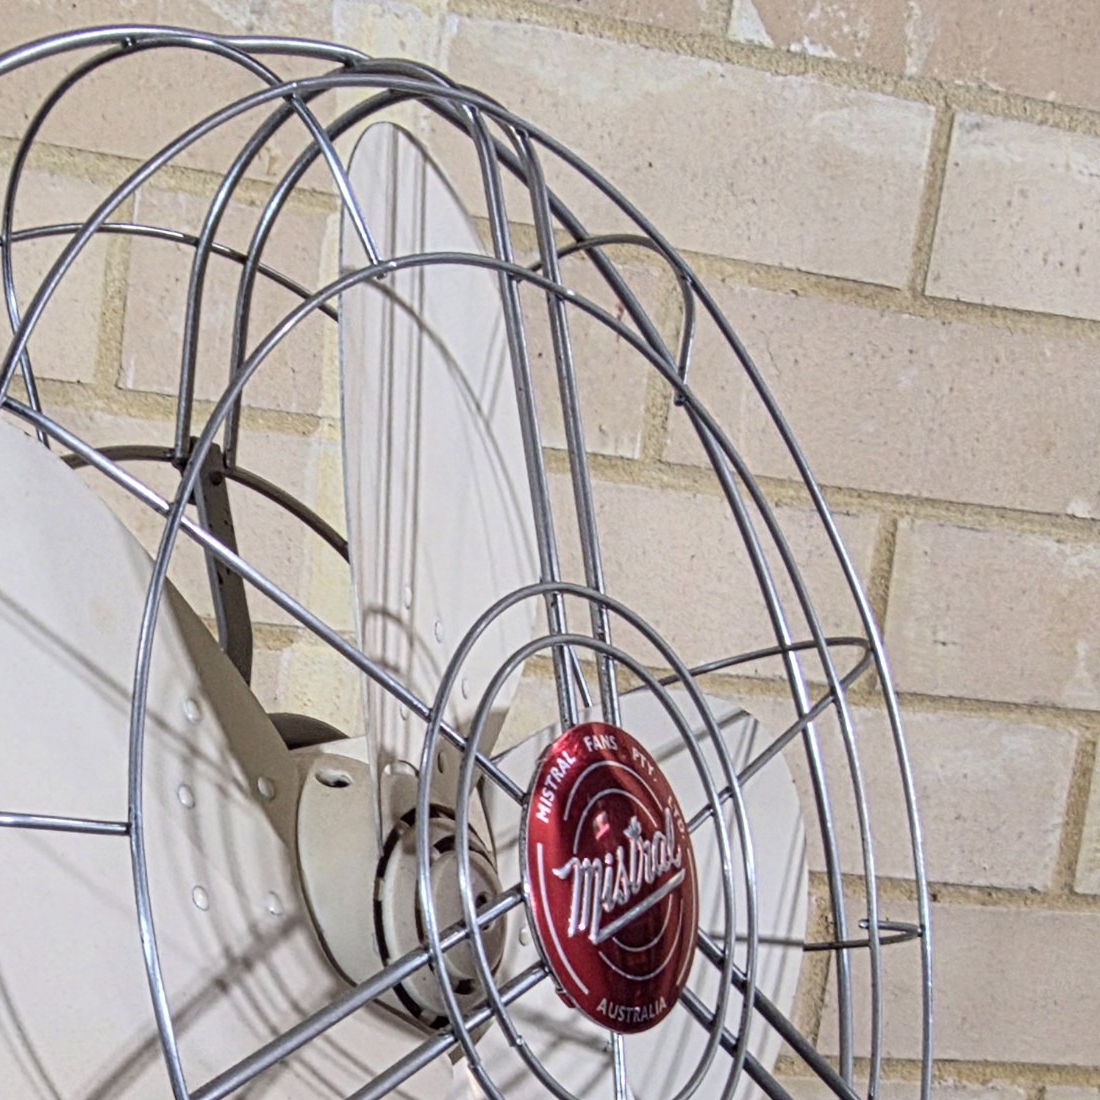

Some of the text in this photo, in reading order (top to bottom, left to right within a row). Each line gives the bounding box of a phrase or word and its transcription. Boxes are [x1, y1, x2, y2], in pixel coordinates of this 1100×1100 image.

[536, 750, 576, 823] MISTRAL
[583, 734, 618, 752] FANS
[552, 807, 686, 945] Mistral
[596, 995, 667, 1023] AUSTRALIA
